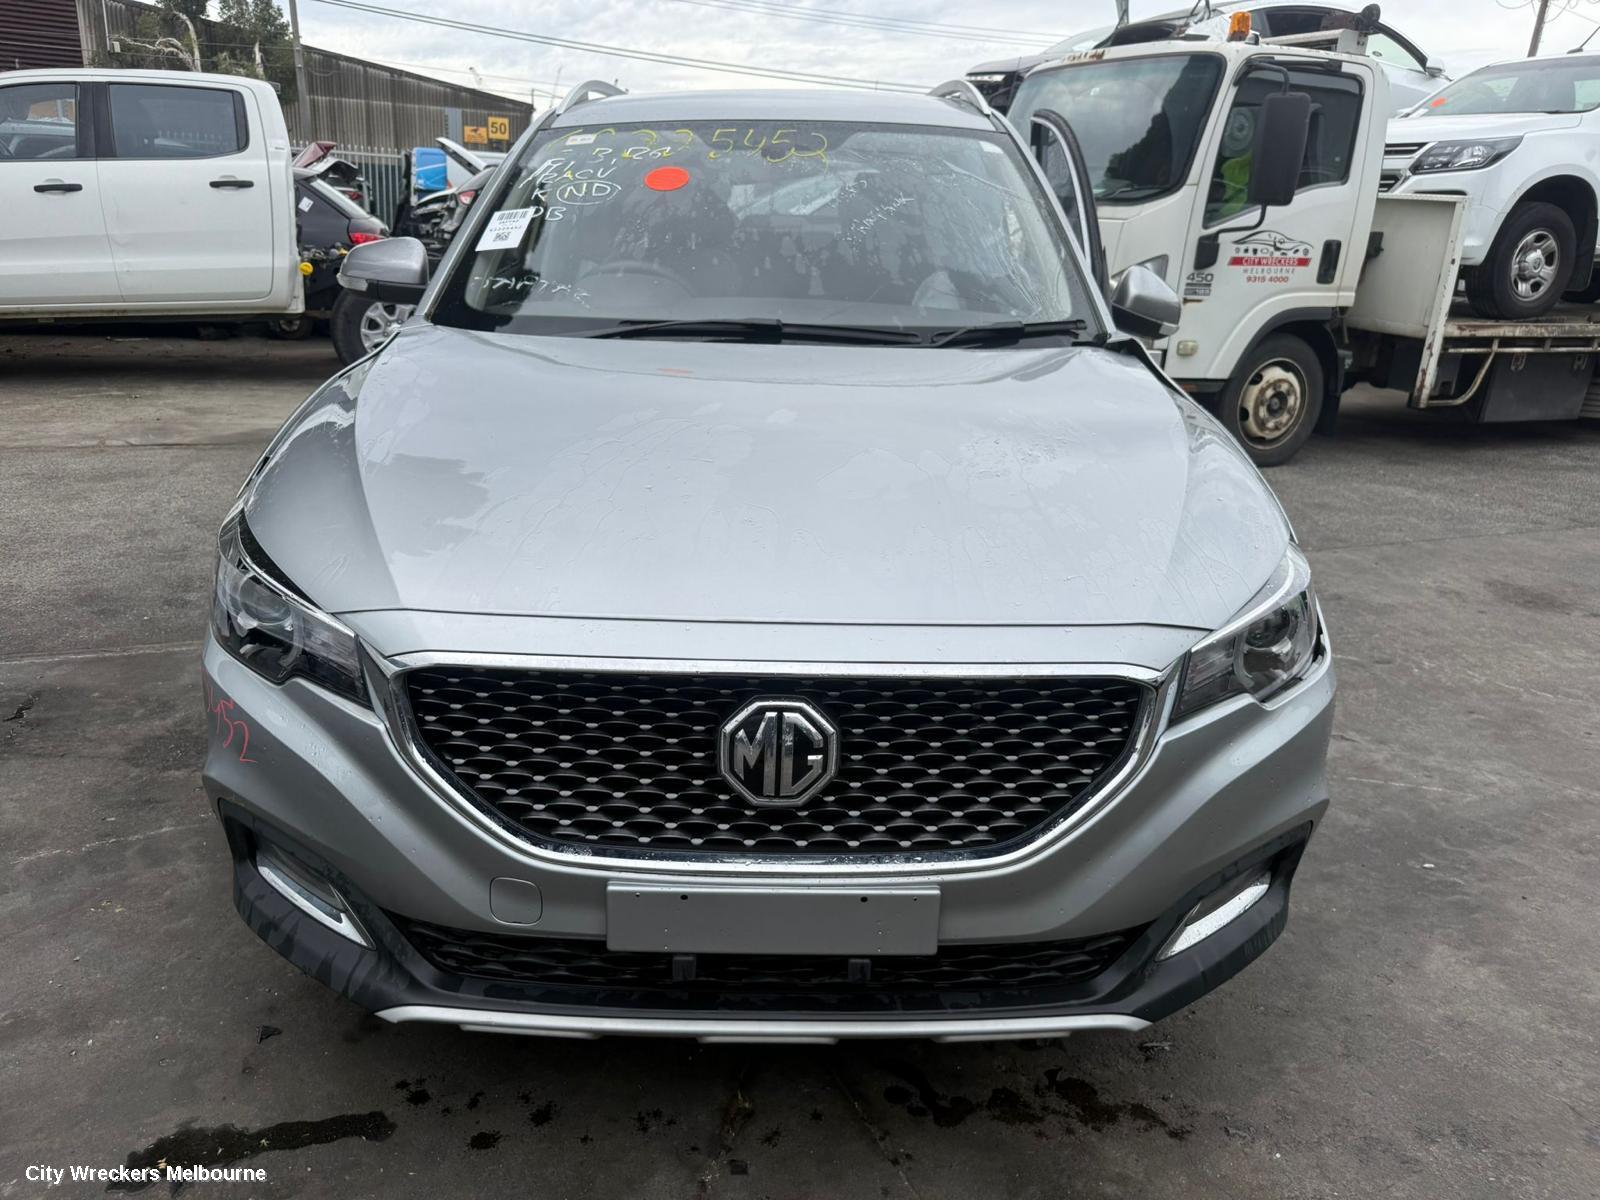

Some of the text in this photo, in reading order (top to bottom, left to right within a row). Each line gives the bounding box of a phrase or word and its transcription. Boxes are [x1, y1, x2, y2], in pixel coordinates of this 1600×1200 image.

[490, 121, 507, 135] 50
[1242, 257, 1298, 266] CITY WRECKERS
[1186, 272, 1214, 283] 450
[733, 711, 824, 797] MG
